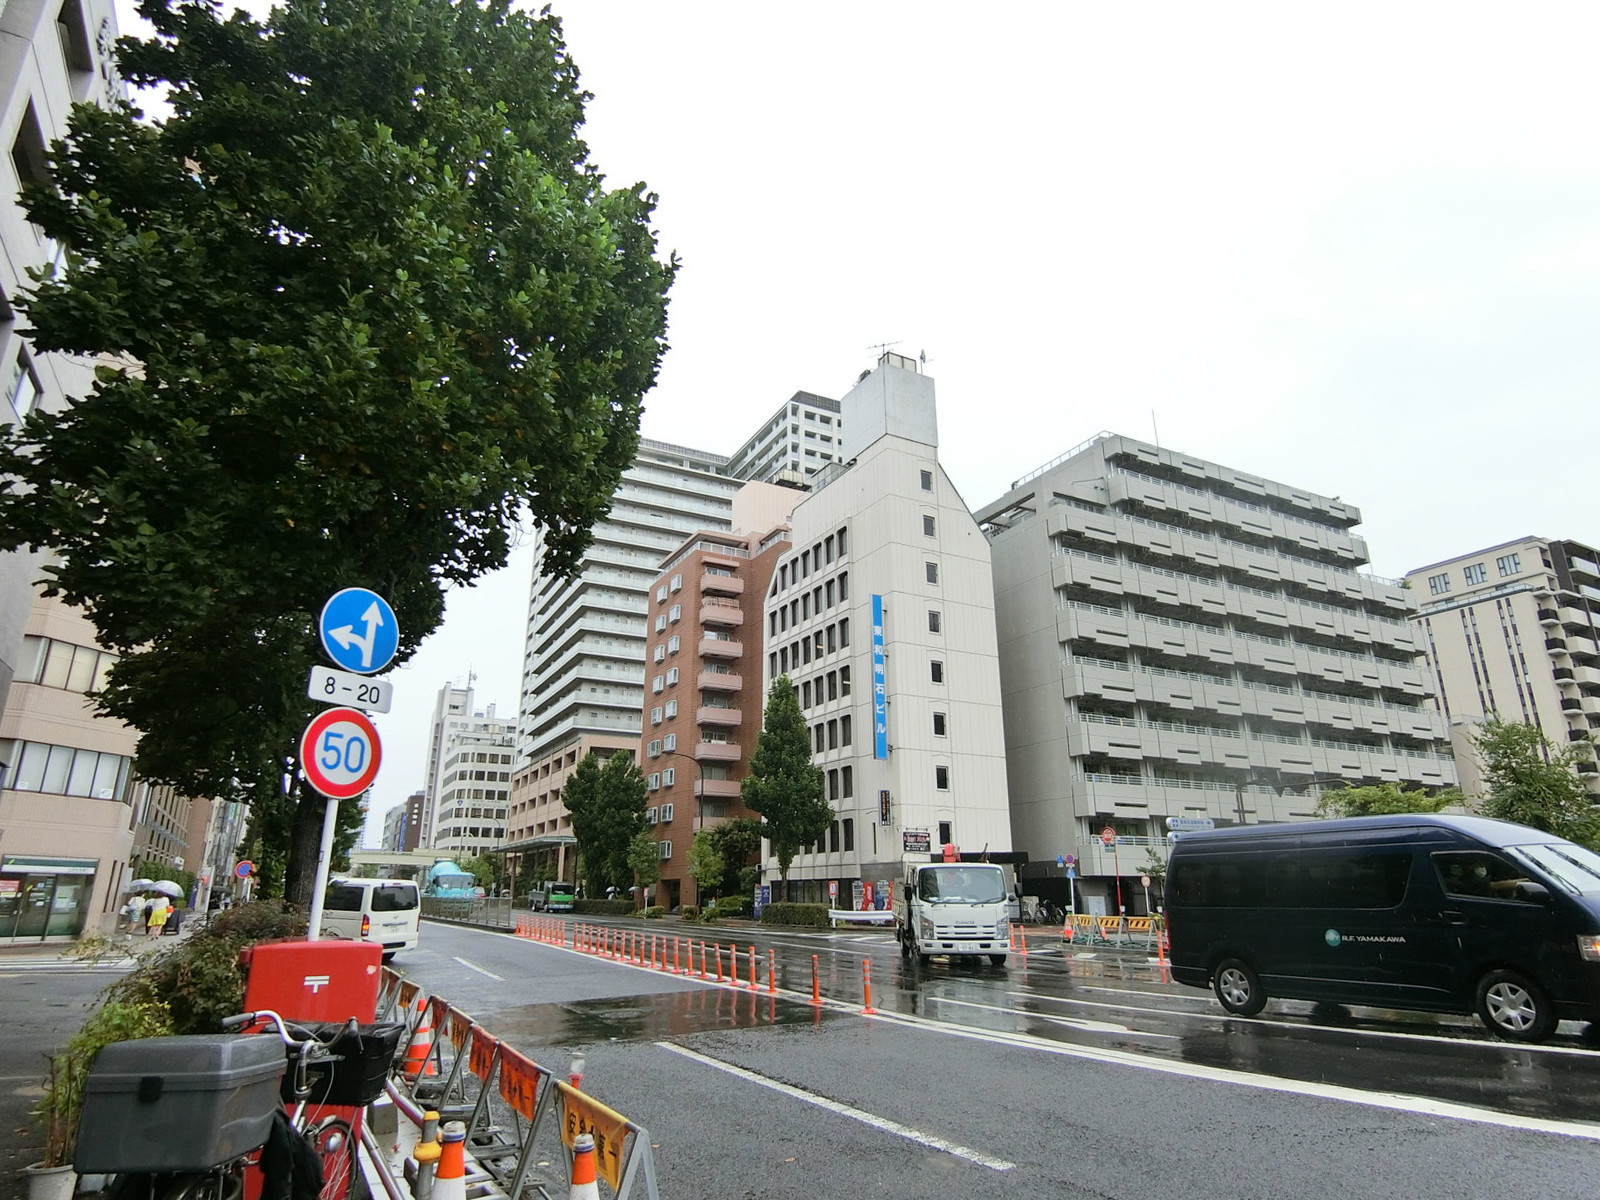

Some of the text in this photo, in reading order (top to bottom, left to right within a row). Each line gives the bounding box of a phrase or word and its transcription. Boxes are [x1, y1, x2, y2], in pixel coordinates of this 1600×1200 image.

[873, 625, 886, 734] 東和明石ビル
[322, 732, 365, 773] 50
[1357, 935, 1406, 943] YAMAKAWA
